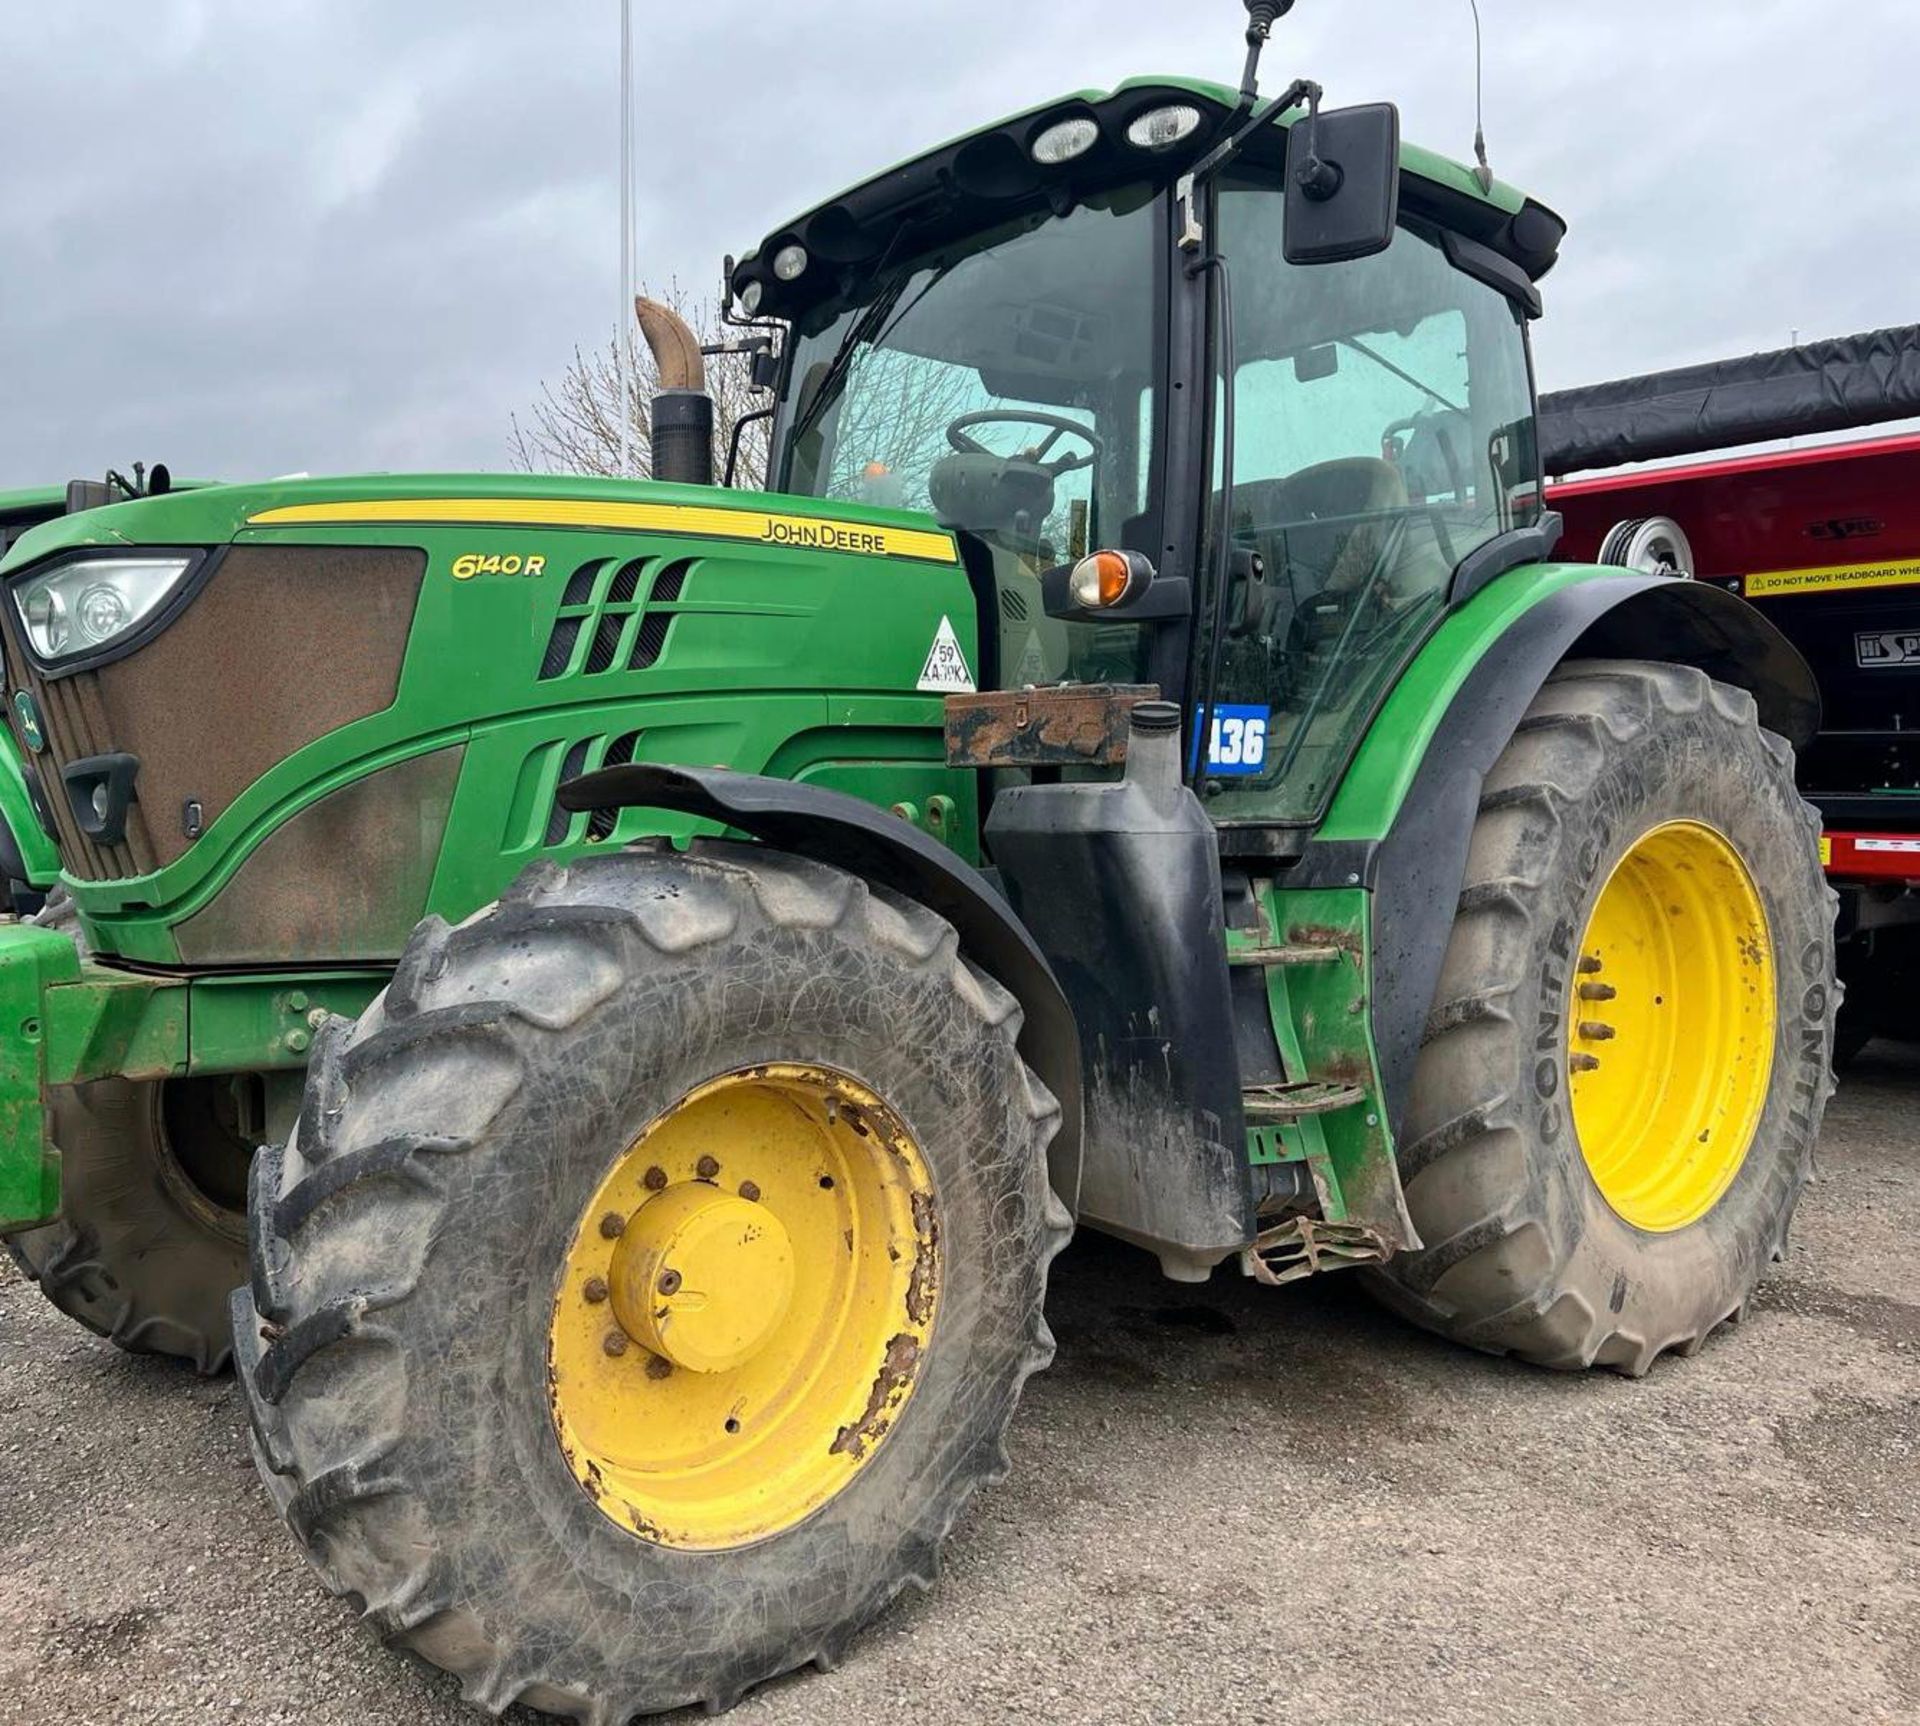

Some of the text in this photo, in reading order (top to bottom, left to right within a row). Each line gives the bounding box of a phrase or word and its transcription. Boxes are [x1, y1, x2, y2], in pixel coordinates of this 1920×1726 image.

[761, 518, 886, 551] JOHN DEERE
[1767, 579, 1782, 587] DO
[1783, 577, 1802, 586] NOT
[1805, 574, 1832, 584] MOVE
[1834, 568, 1897, 581] HEADBOARD
[939, 645, 955, 663] 59
